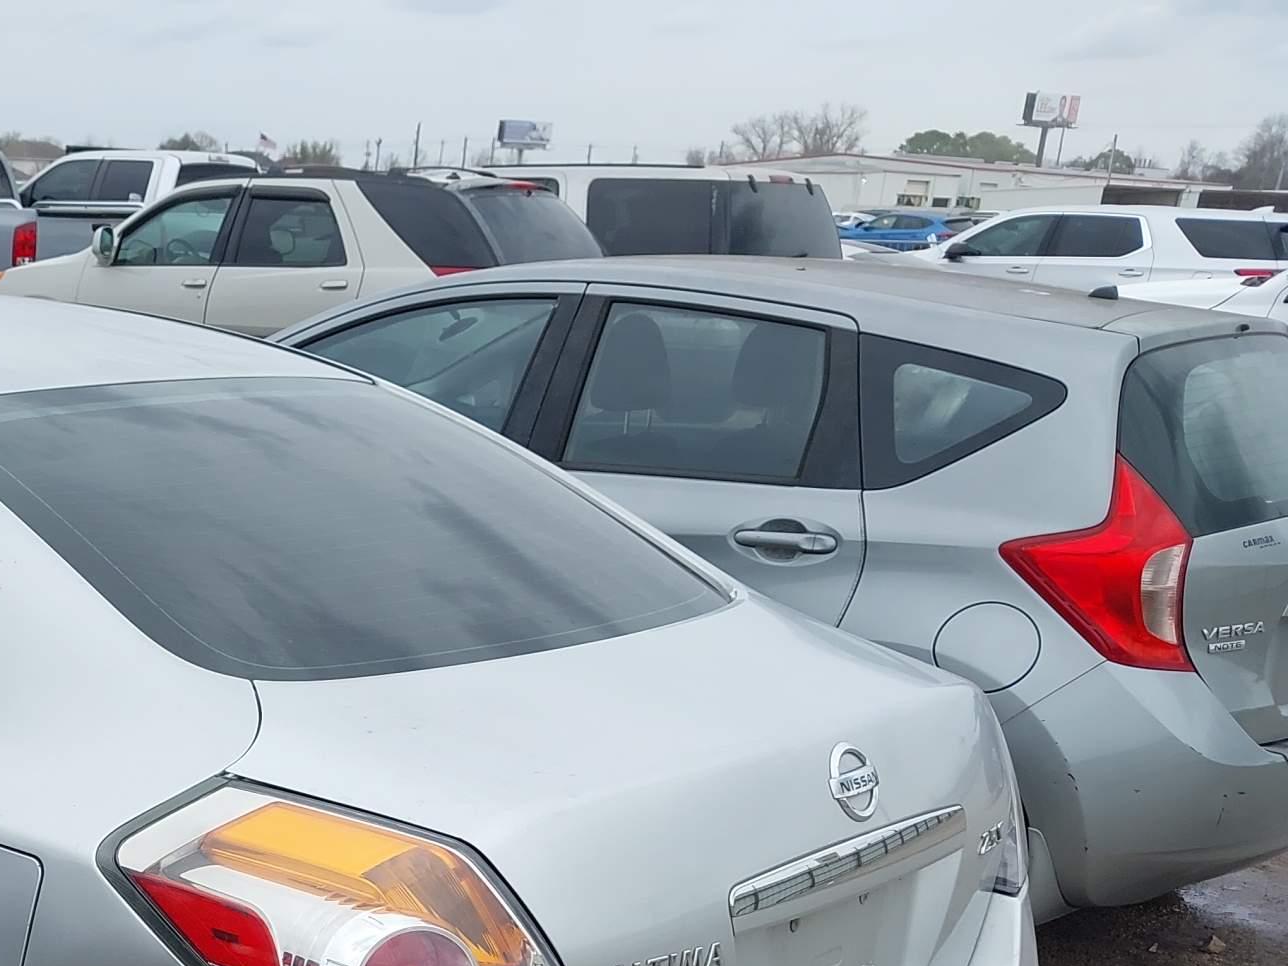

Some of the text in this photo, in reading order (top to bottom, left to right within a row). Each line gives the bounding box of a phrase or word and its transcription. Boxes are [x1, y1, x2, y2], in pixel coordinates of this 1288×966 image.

[1201, 621, 1265, 640] VERSA
[1214, 641, 1242, 652] NOTE
[839, 771, 879, 794] NISSAN
